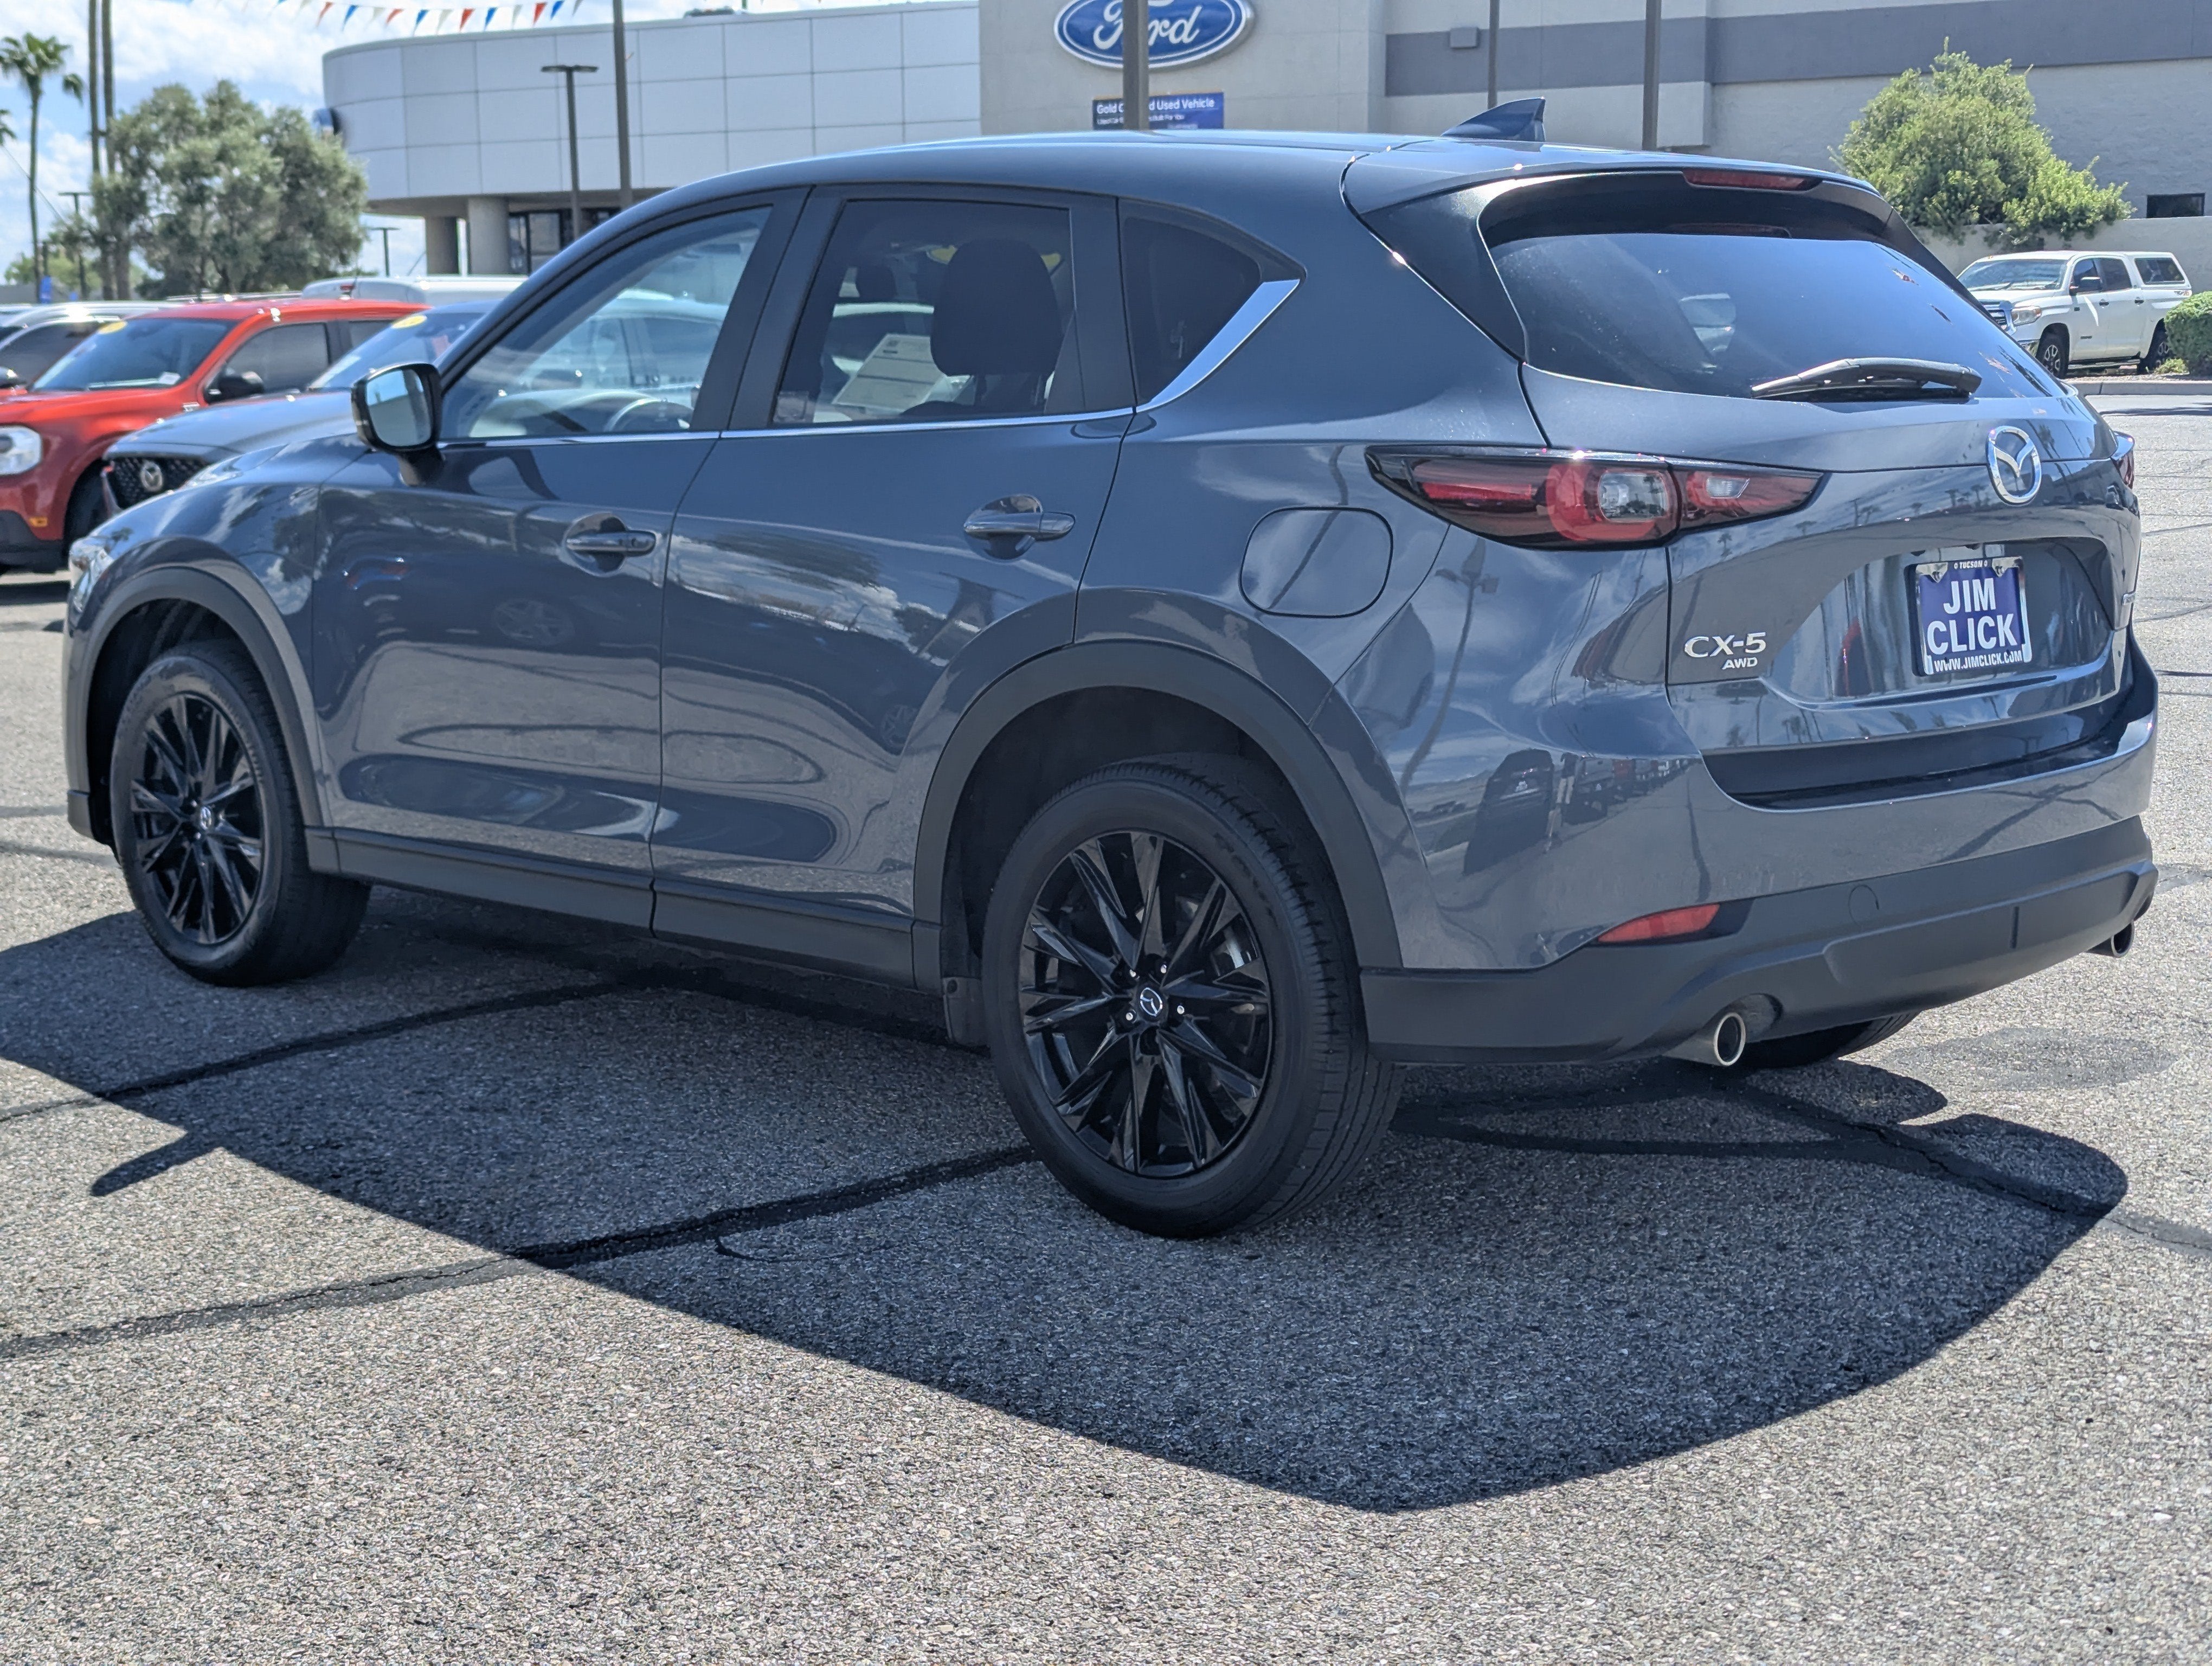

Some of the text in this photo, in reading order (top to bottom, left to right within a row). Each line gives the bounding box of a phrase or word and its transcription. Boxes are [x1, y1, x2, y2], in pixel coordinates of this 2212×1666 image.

[1093, 0, 1202, 50] Frd
[1096, 102, 1117, 114] Gold
[1156, 99, 1180, 111] Used
[1181, 97, 1215, 109] Vehicle
[1959, 560, 1983, 569] TUCSON
[1943, 578, 1996, 614] JIM
[1684, 632, 1766, 658] CX-5
[1927, 613, 2018, 655] CLICK
[1722, 657, 1758, 670] AWD
[1934, 650, 2023, 672] WWW.JIMCLICK.COM
